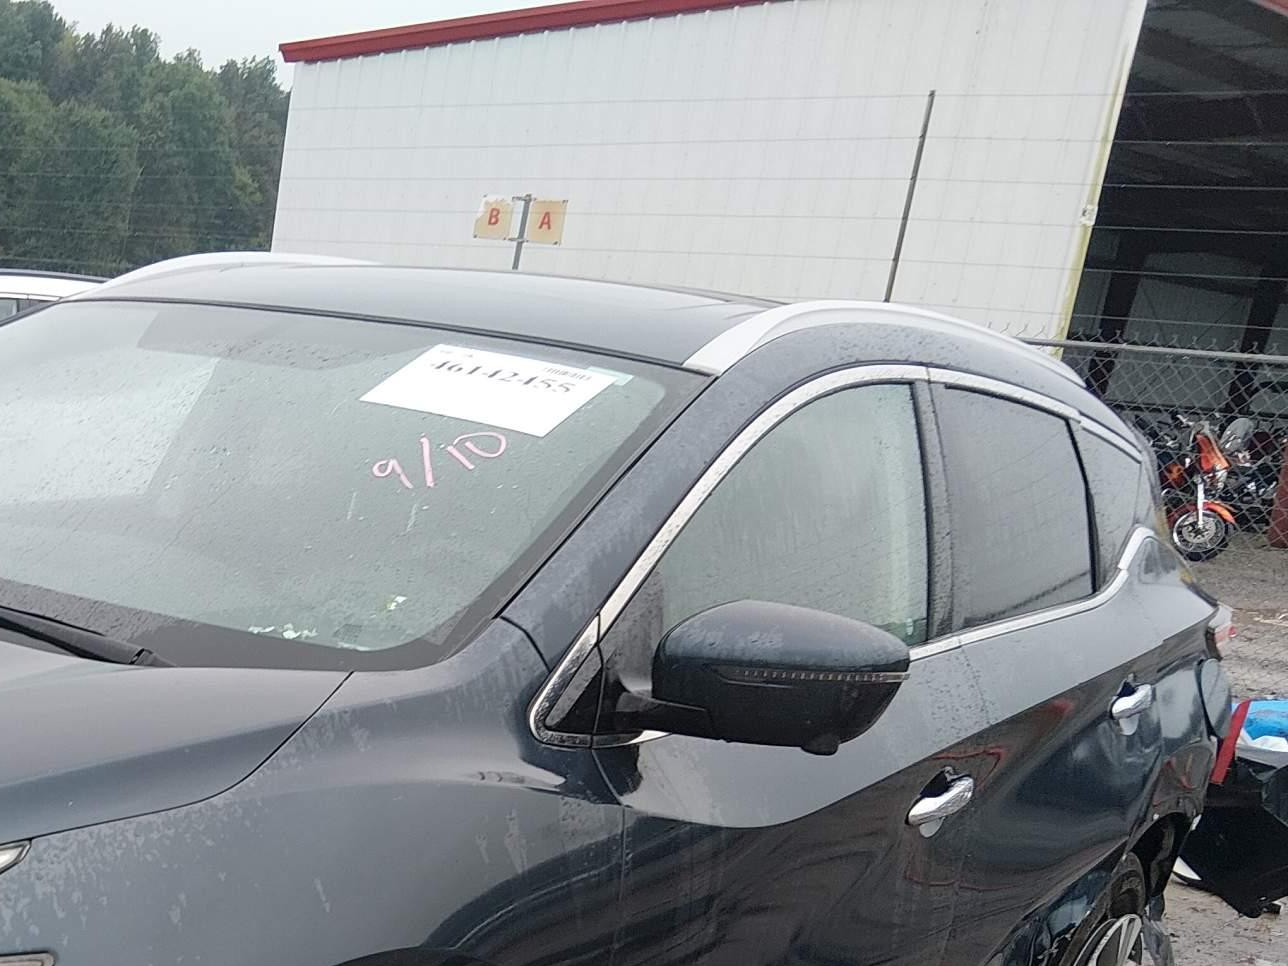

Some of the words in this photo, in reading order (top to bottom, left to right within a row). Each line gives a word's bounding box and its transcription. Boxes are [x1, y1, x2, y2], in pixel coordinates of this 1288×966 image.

[487, 207, 500, 226] B
[538, 211, 552, 230] A
[372, 431, 507, 489] 9/10
